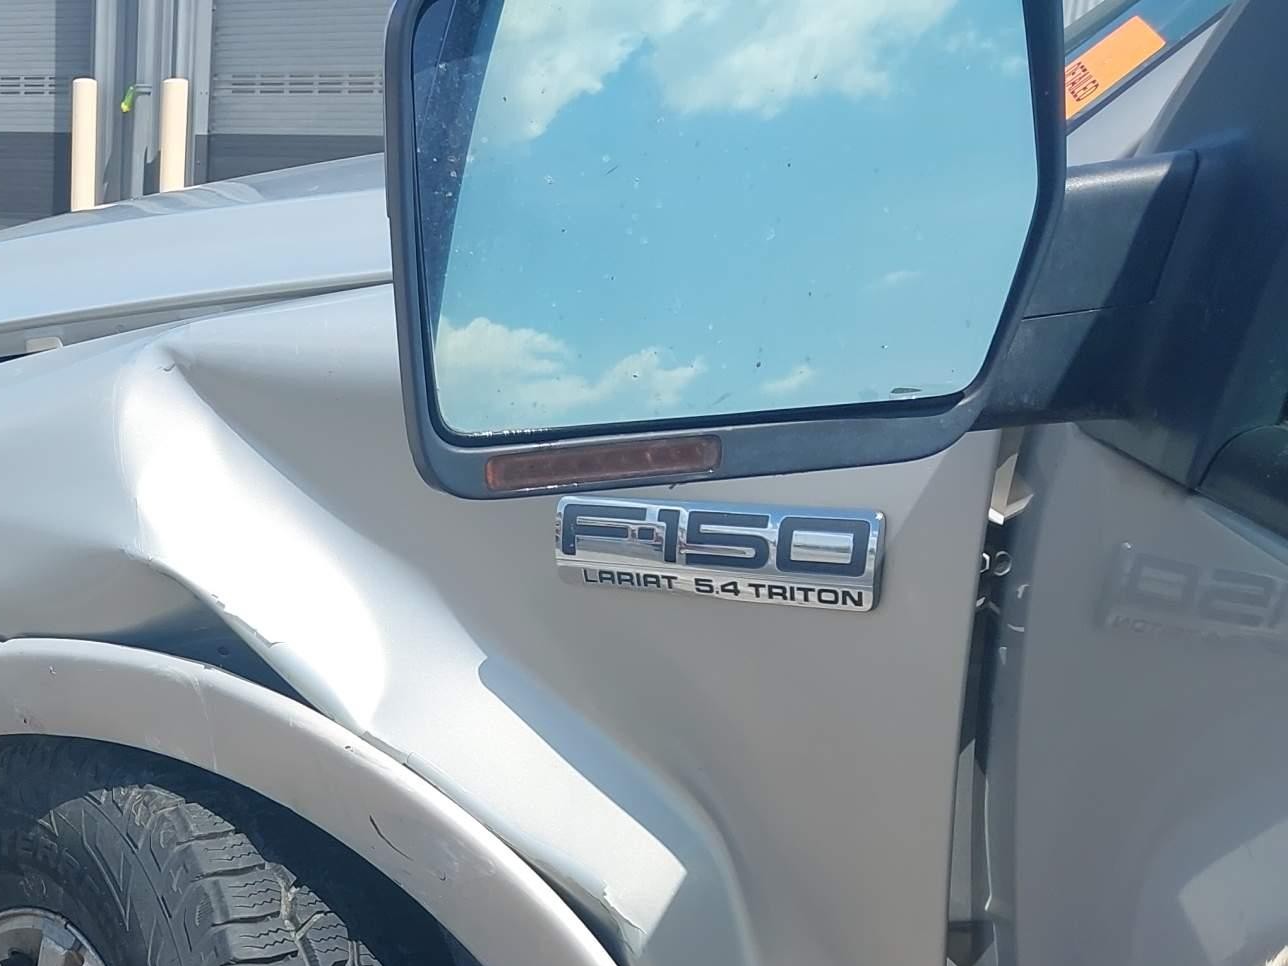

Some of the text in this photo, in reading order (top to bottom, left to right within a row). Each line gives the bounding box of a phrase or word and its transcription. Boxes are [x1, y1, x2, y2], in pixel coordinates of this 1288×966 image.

[562, 503, 871, 577] F-150
[583, 568, 864, 607] LARIAT 5.4 TRITON
